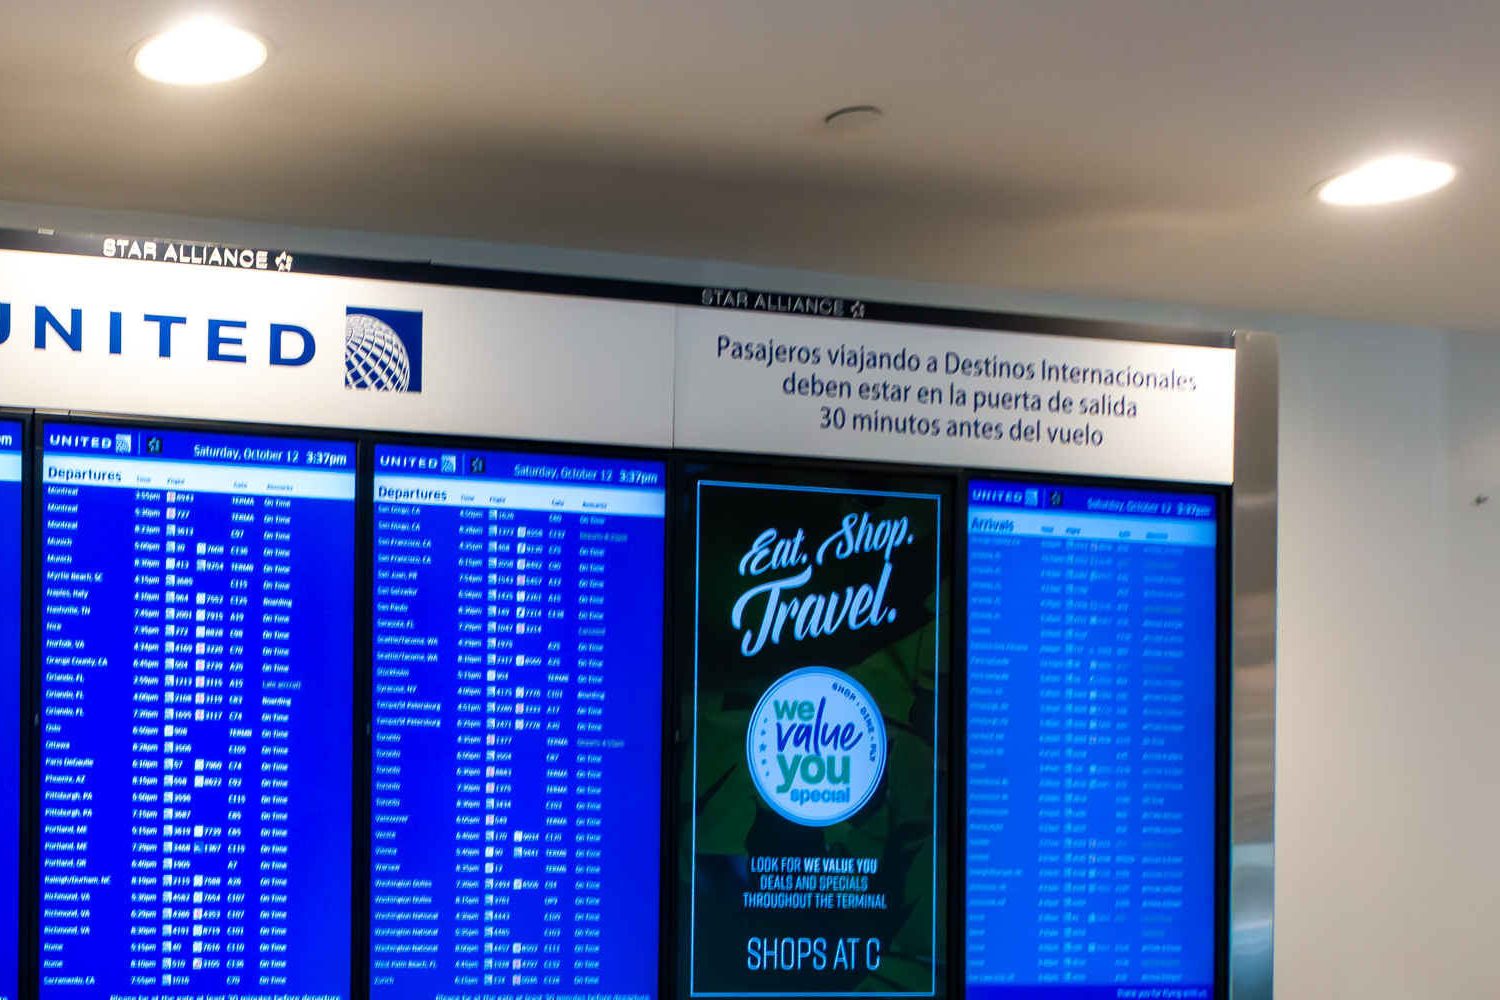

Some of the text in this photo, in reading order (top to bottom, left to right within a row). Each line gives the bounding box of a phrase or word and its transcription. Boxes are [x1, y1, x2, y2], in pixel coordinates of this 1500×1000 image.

[103, 238, 267, 270] STAR ALLIANCE
[701, 290, 842, 318] STAR ALLIANCE
[717, 336, 1197, 392] Pasajeros viajando a Destinos Internacionales
[782, 373, 1136, 415] deben estar en la puerta de salida
[820, 407, 1103, 447] 30 minutos antes del vuelo
[49, 434, 111, 448] UNITED
[192, 444, 347, 466] Saturday, October 12 3:37pm
[379, 455, 438, 468] UNITED
[47, 466, 124, 486] Departures
[514, 464, 657, 484] Saturday, October 12 3:37pm
[378, 486, 449, 504] Departures
[970, 514, 1016, 536] Arrivals
[738, 511, 914, 576] Eat. Shop.
[731, 562, 898, 658] Travel.
[773, 698, 815, 722] we
[775, 696, 864, 756] value
[775, 753, 851, 794] you
[789, 786, 851, 806] special
[750, 856, 878, 876] LOOK FOR WE VALUE YOU
[759, 874, 869, 892] DEALS AND SPECIALS
[742, 891, 887, 910] THROUGHOUT THE TERMINAL
[747, 937, 880, 970] SHOPS AT C
